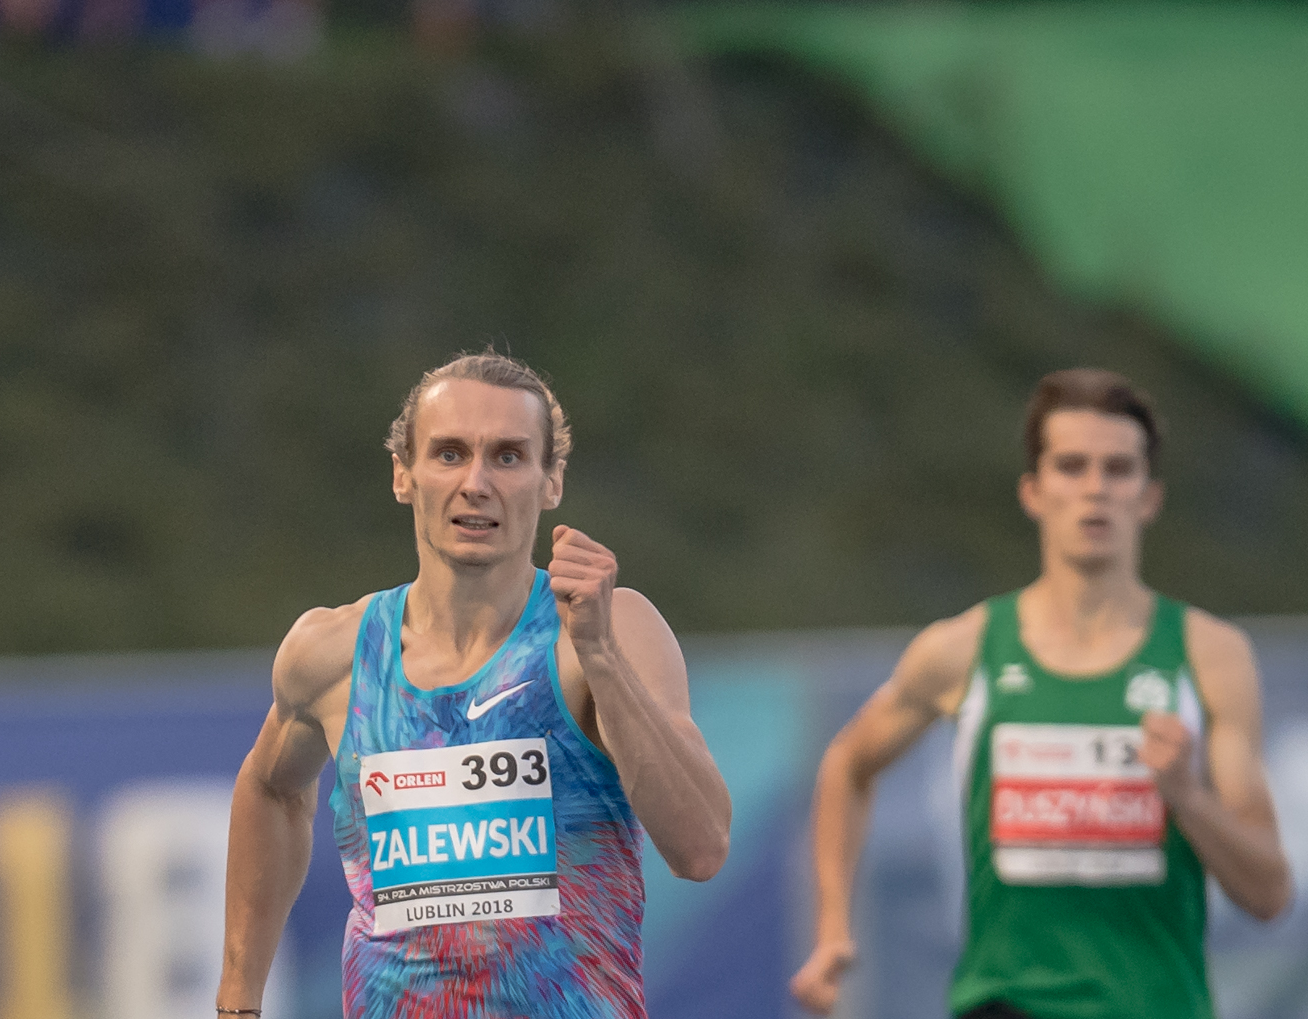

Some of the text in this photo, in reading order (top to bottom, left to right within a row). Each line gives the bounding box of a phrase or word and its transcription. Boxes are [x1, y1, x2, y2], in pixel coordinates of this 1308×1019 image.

[396, 773, 442, 787] ORLEN
[461, 750, 547, 790] 393
[372, 816, 548, 871] ZALEWSKI
[392, 888, 417, 900] PZLA
[419, 881, 506, 896] MISTRZOSTWA
[509, 877, 551, 888] POLSKI
[406, 899, 514, 922] LUBLIN 2018
